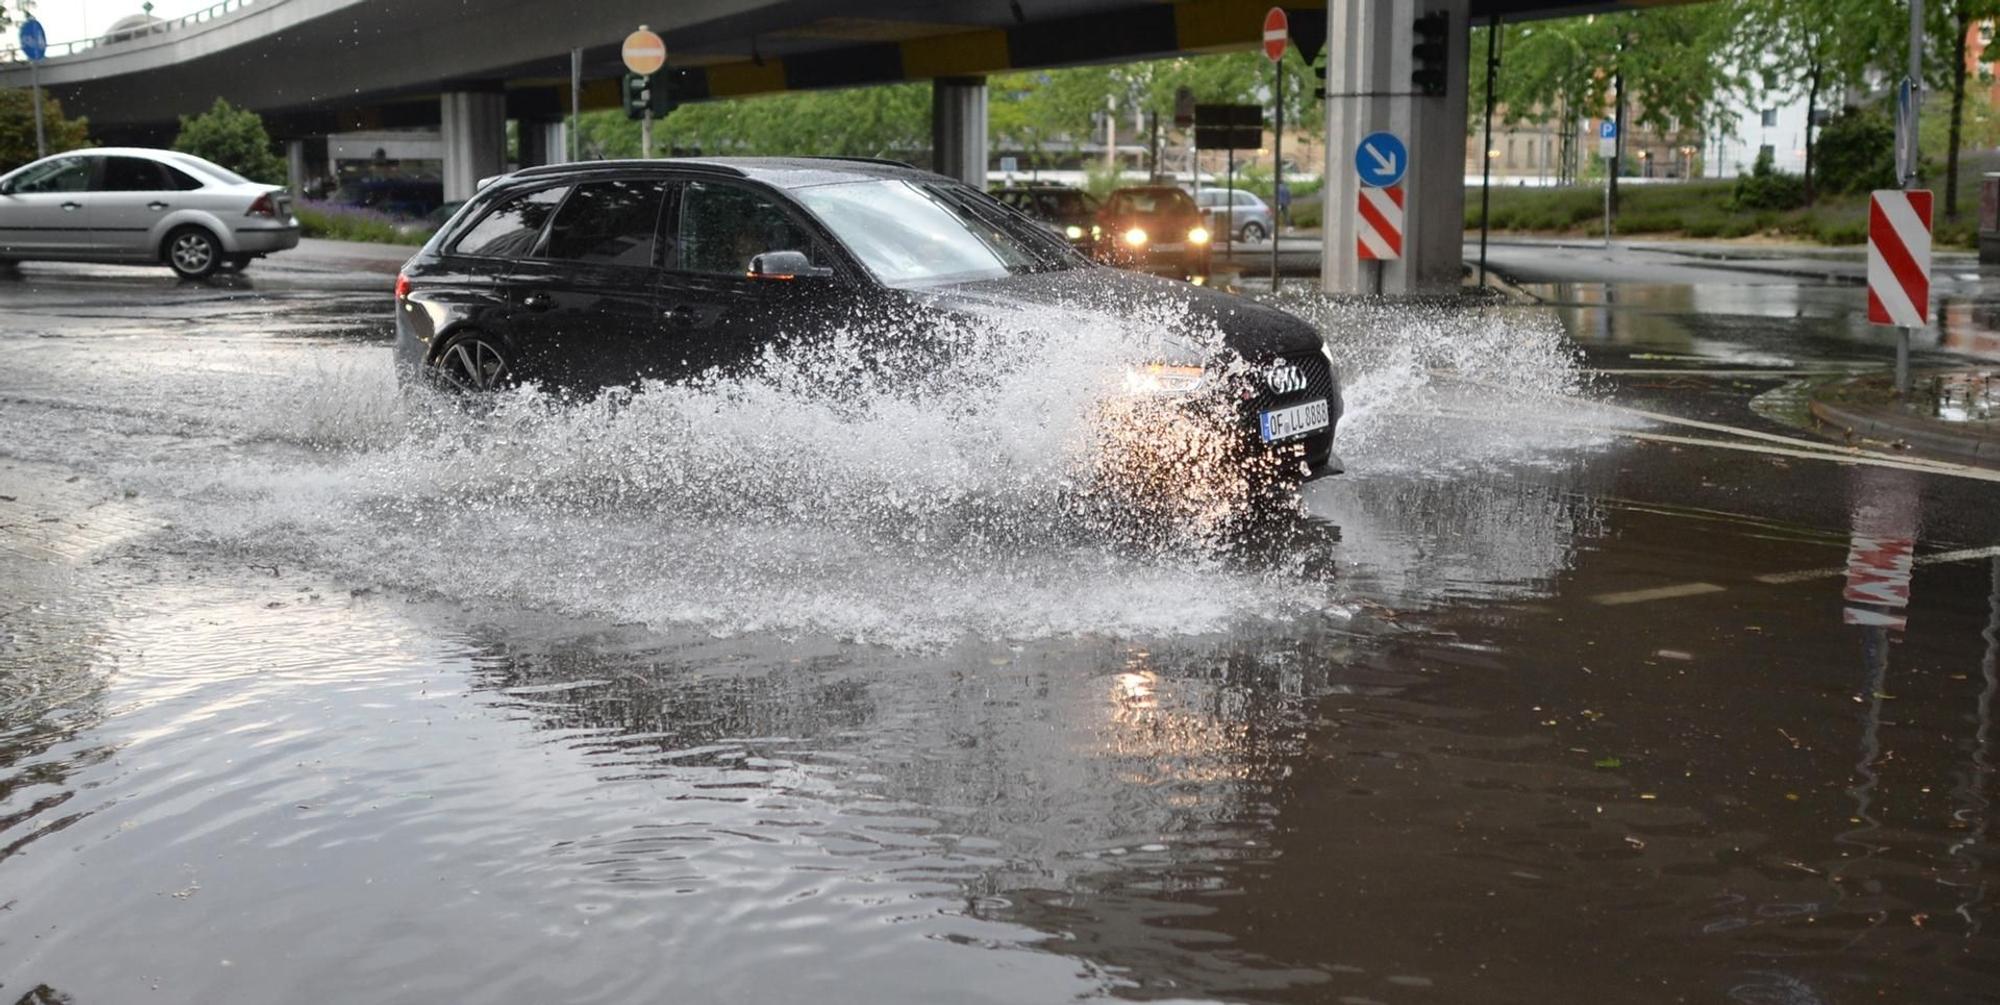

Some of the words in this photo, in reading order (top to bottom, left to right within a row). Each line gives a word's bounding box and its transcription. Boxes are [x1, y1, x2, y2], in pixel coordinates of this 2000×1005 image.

[1603, 123, 1613, 137] P
[1270, 413, 1283, 435] OF
[1290, 409, 1304, 431] LL
